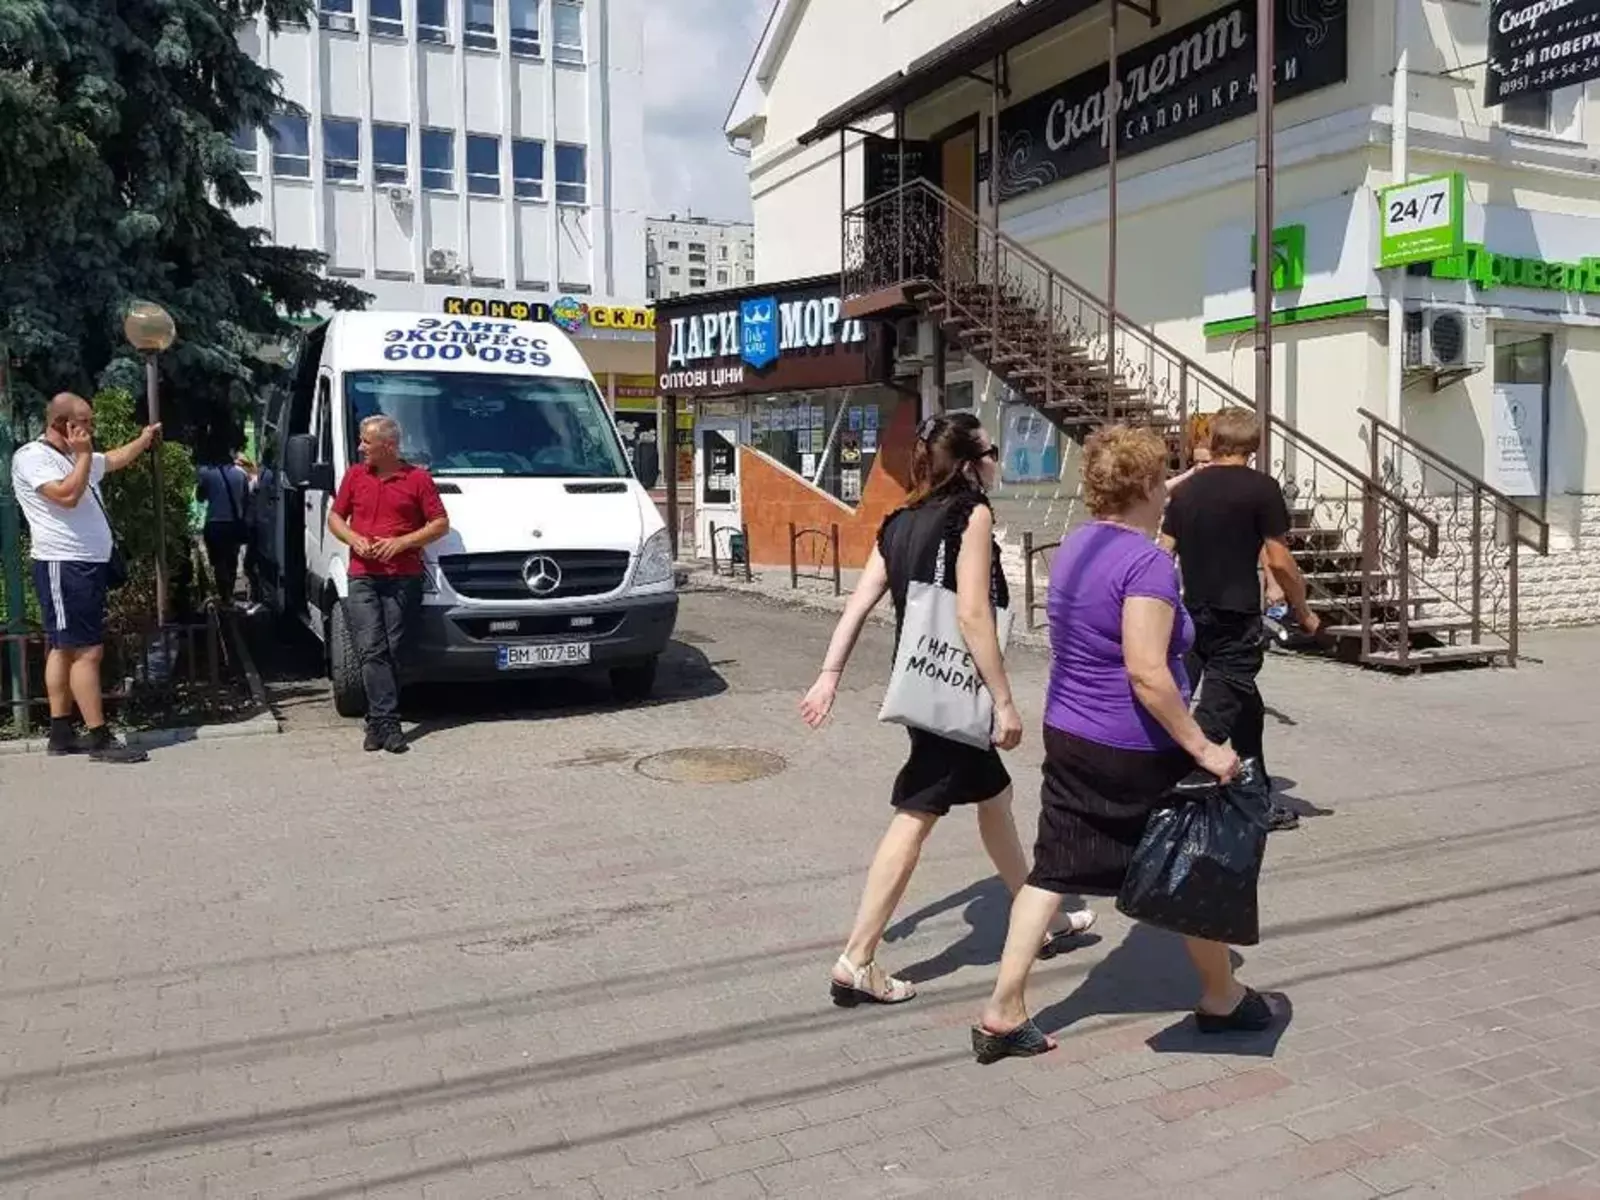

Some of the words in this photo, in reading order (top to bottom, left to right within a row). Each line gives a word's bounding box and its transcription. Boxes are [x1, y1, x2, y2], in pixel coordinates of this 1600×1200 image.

[1125, 94, 1198, 140] САЛОН
[1211, 57, 1296, 107] КРАИ
[1390, 192, 1445, 224] 24/7
[594, 309, 657, 326] СКЛ
[667, 311, 741, 368] ДАРИ
[383, 343, 463, 361] 600
[479, 346, 552, 367] 089
[659, 370, 707, 390] ОПТОВІ
[711, 367, 743, 387] ЦІНИ
[509, 648, 529, 662] BM
[567, 644, 587, 659] BK
[928, 638, 972, 668] HATE
